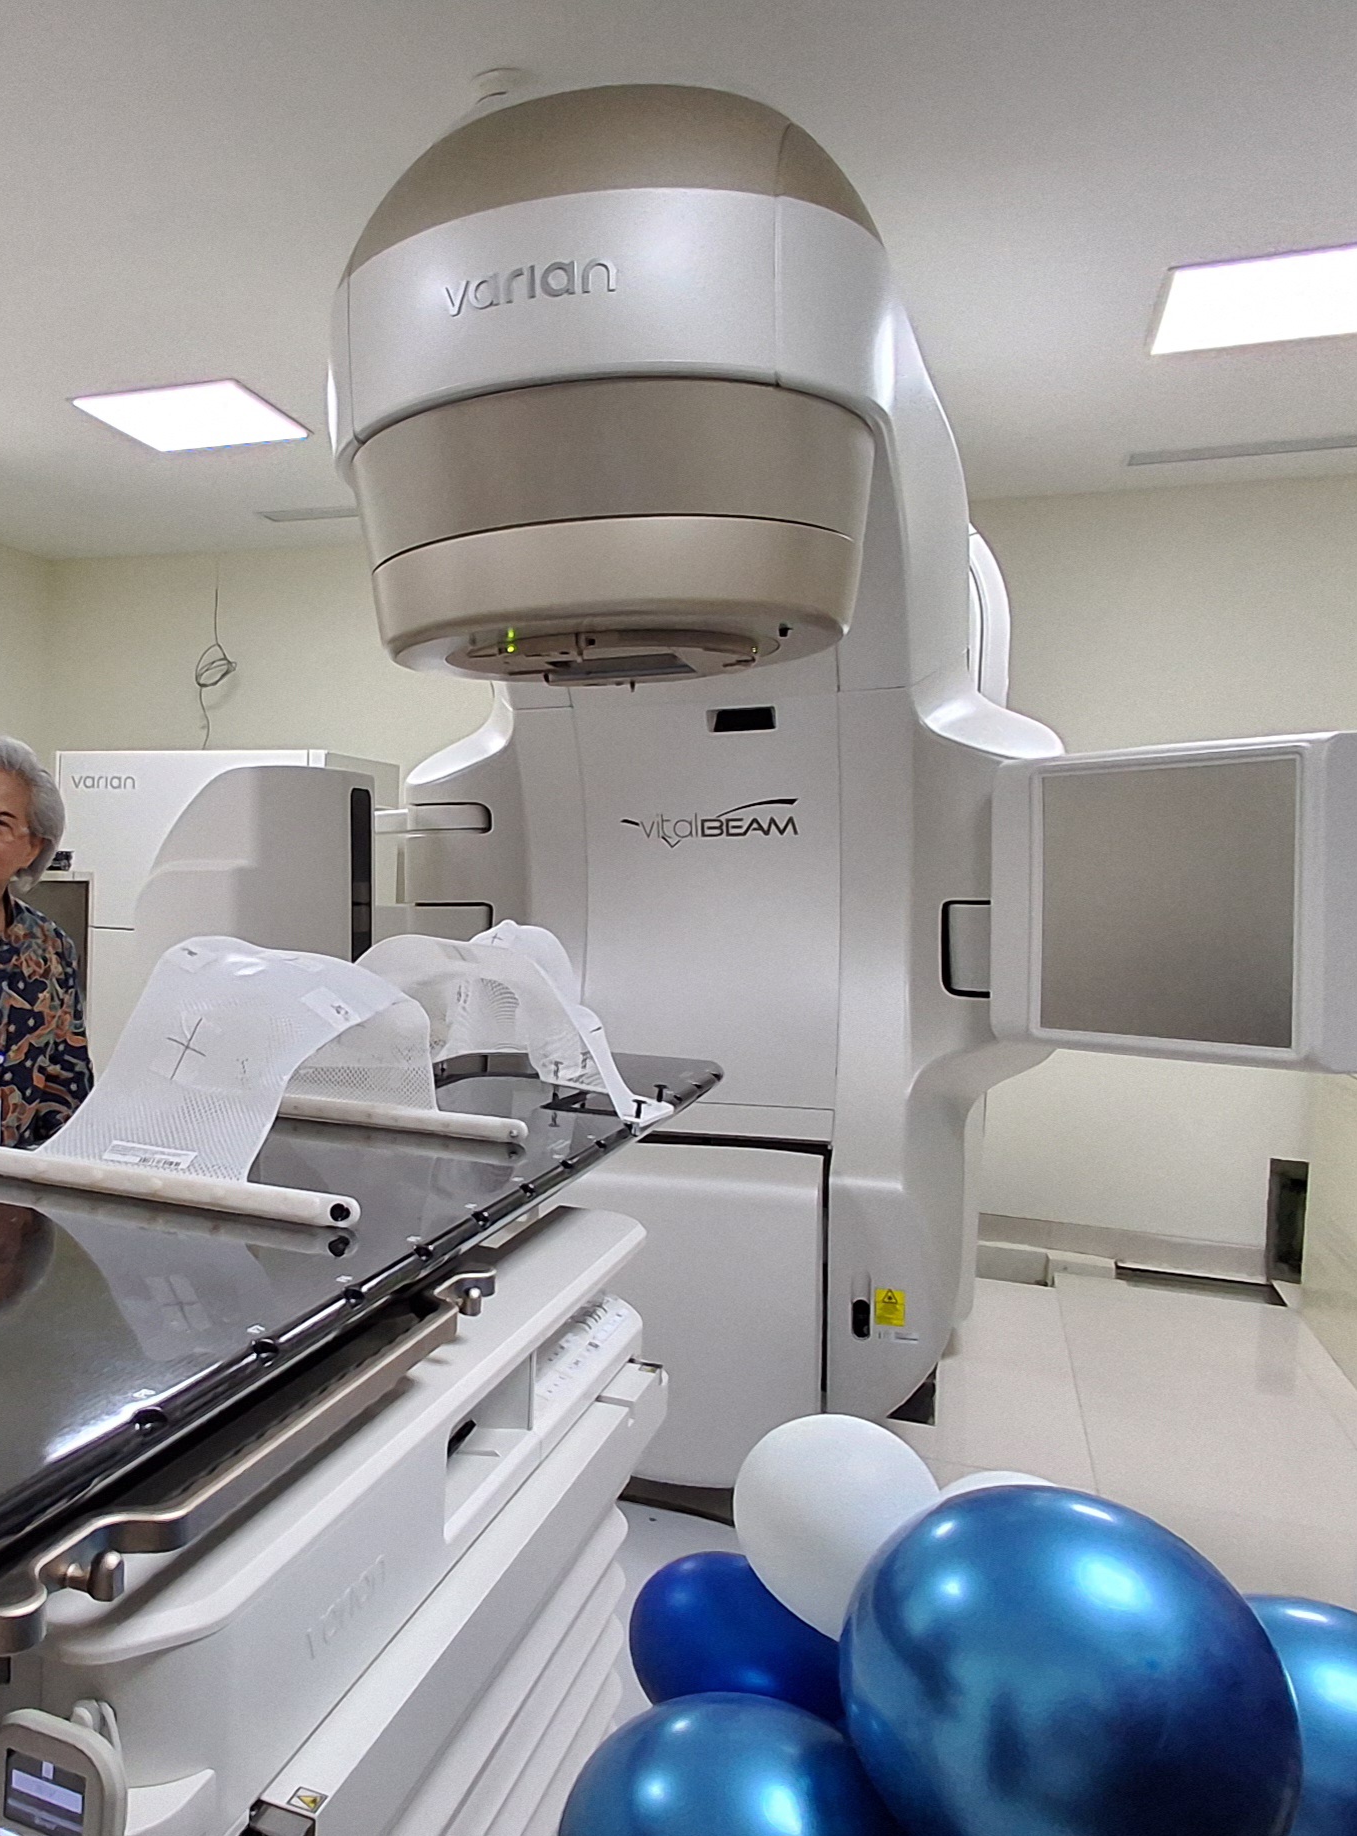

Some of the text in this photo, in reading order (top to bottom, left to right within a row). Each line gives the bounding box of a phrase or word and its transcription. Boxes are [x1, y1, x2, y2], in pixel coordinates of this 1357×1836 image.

[445, 258, 618, 317] varian
[70, 775, 136, 790] varian
[638, 809, 800, 841] vitalBEAM
